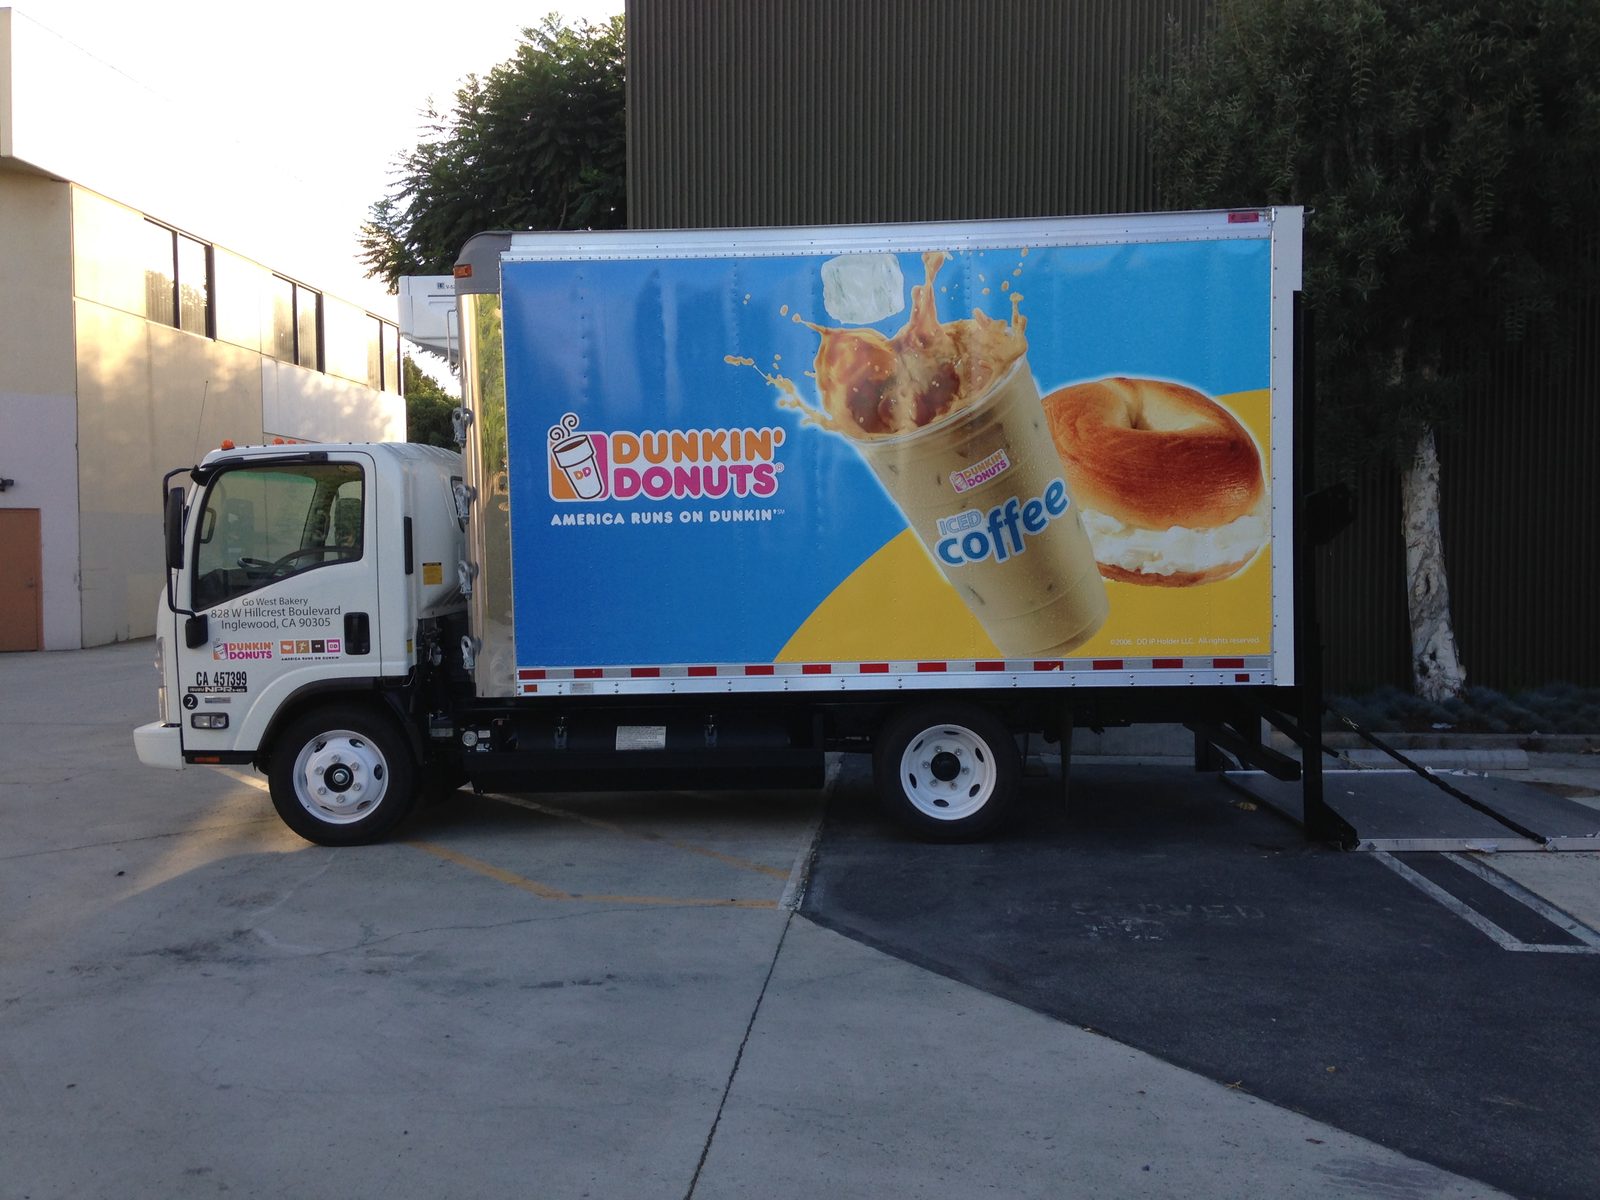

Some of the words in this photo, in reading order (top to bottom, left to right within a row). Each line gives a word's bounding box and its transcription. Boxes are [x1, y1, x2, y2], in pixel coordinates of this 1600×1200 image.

[612, 429, 783, 465] DUNKIN'
[573, 466, 592, 481] DD
[613, 463, 776, 498] DONUTS
[967, 459, 1008, 488] DONUTS
[550, 512, 625, 526] AMERICA
[631, 511, 674, 525] RUNS
[679, 510, 704, 524] ON
[709, 508, 778, 523] DUNKIN'
[938, 480, 1068, 565] coffee
[939, 510, 982, 536] ICED
[242, 598, 254, 607] Go
[256, 597, 278, 607] West
[279, 596, 309, 608] Bakery
[211, 609, 230, 619] 828
[232, 608, 242, 618] W
[244, 606, 286, 618] Hillcrest
[288, 605, 341, 617] Boulevard
[221, 618, 280, 632] Inglewood,
[281, 618, 297, 629] CA
[299, 617, 331, 628] 90305
[229, 641, 274, 651] DUNKIN'
[229, 650, 272, 660] DONUTS
[196, 671, 209, 686] CA
[213, 670, 247, 687] 457399
[187, 696, 194, 707] 2
